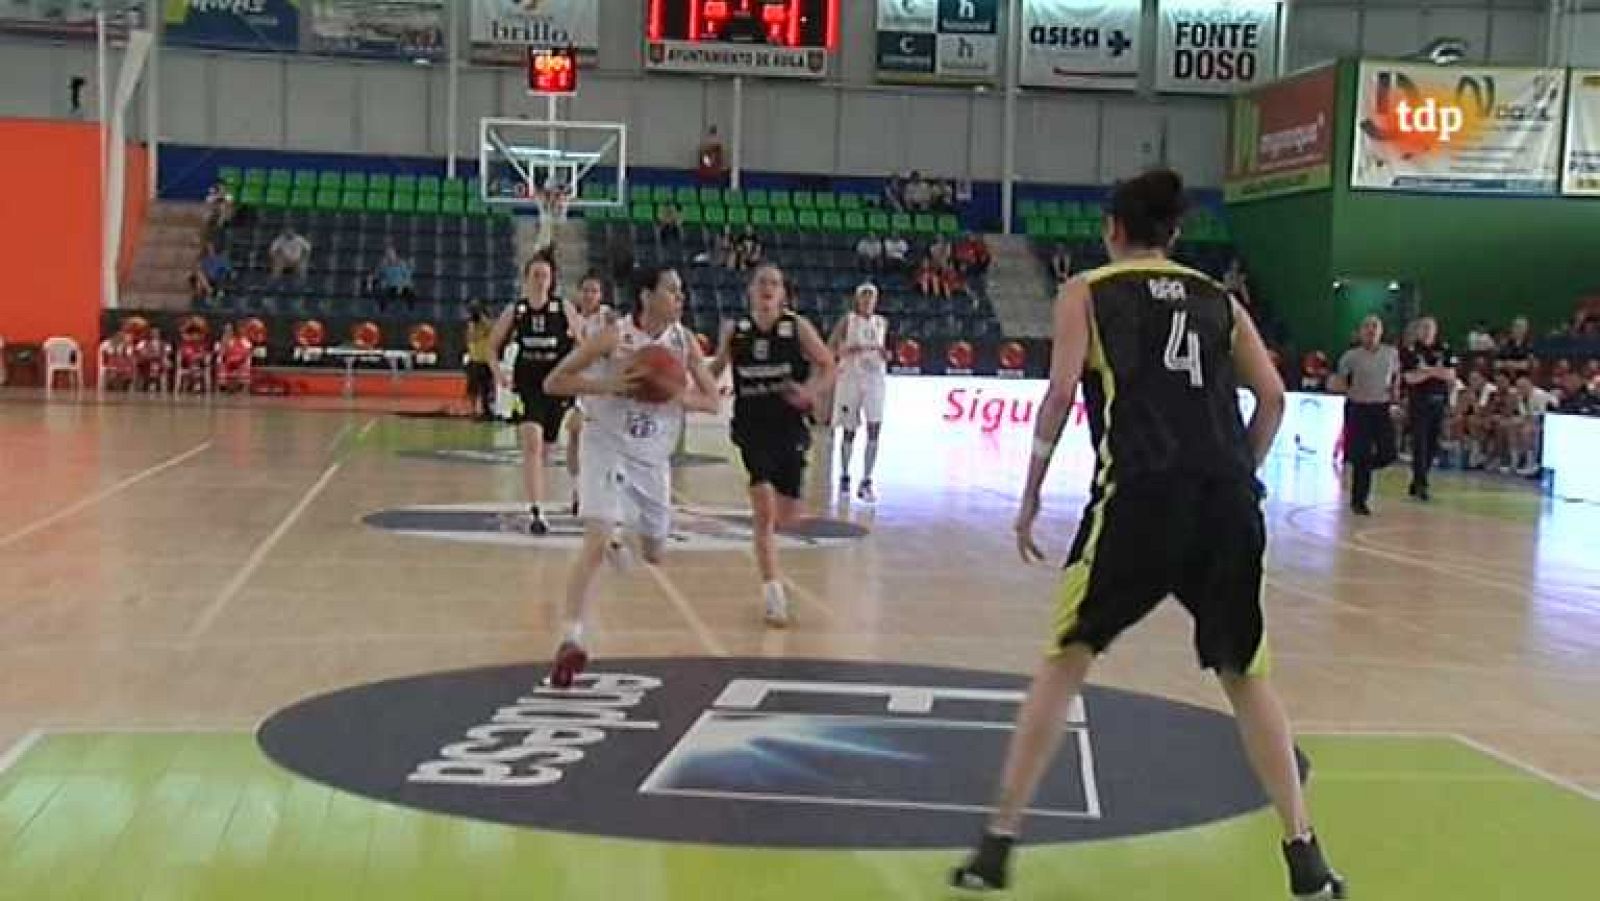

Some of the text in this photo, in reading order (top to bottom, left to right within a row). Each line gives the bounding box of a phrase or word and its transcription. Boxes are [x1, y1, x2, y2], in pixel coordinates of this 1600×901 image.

[491, 20, 569, 41] brillo
[1029, 25, 1099, 48] asisa
[1175, 22, 1258, 49] FONTE
[755, 53, 771, 67] DE
[1174, 50, 1256, 80] DOSO
[1163, 310, 1204, 387] 4
[406, 672, 664, 786] endesa
